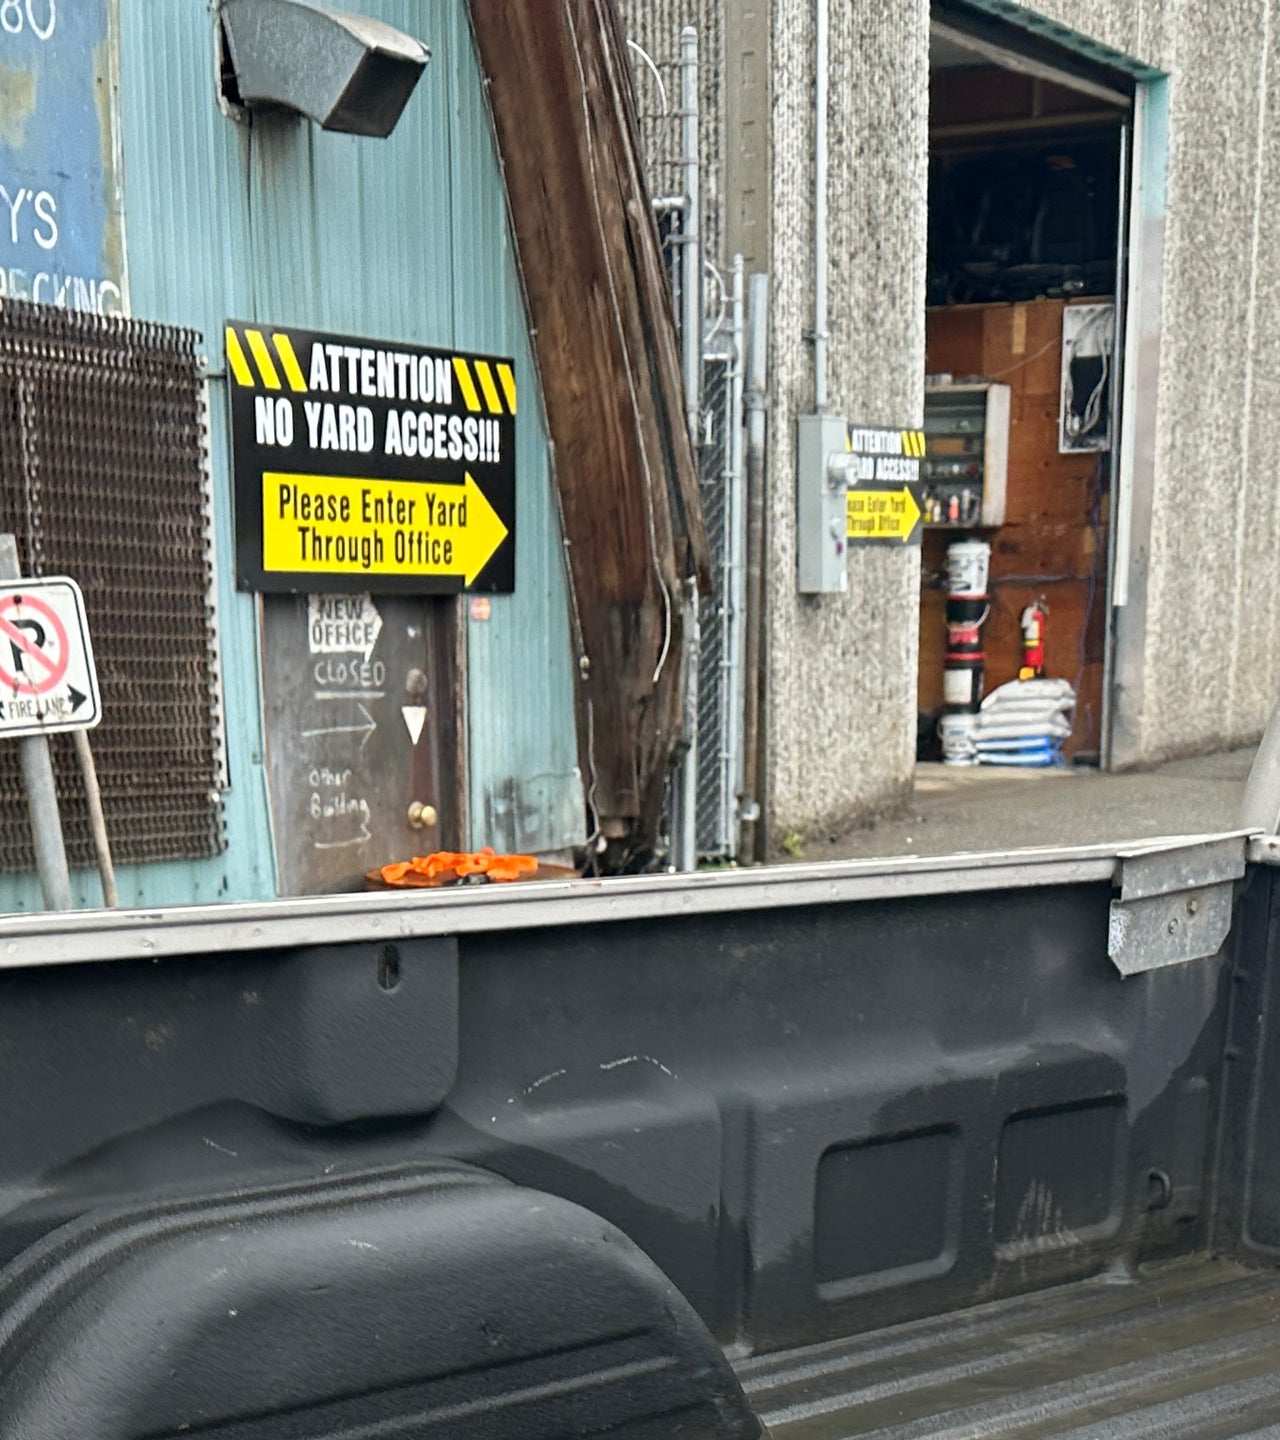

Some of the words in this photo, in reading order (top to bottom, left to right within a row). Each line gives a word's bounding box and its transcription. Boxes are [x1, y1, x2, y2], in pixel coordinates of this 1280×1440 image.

[309, 342, 453, 405] ATTENTION
[254, 396, 294, 447] NO
[304, 401, 374, 452] YARD
[384, 409, 500, 463] ACCESS!!!
[851, 429, 902, 454] ATTENTION
[279, 484, 350, 521] Please
[361, 489, 416, 525] Enter
[426, 492, 467, 527] Yard
[298, 526, 384, 569] Through
[395, 529, 453, 565] Office
[318, 597, 363, 620] NEW
[311, 621, 374, 646] OFFICE
[8, 700, 35, 719] FIRE
